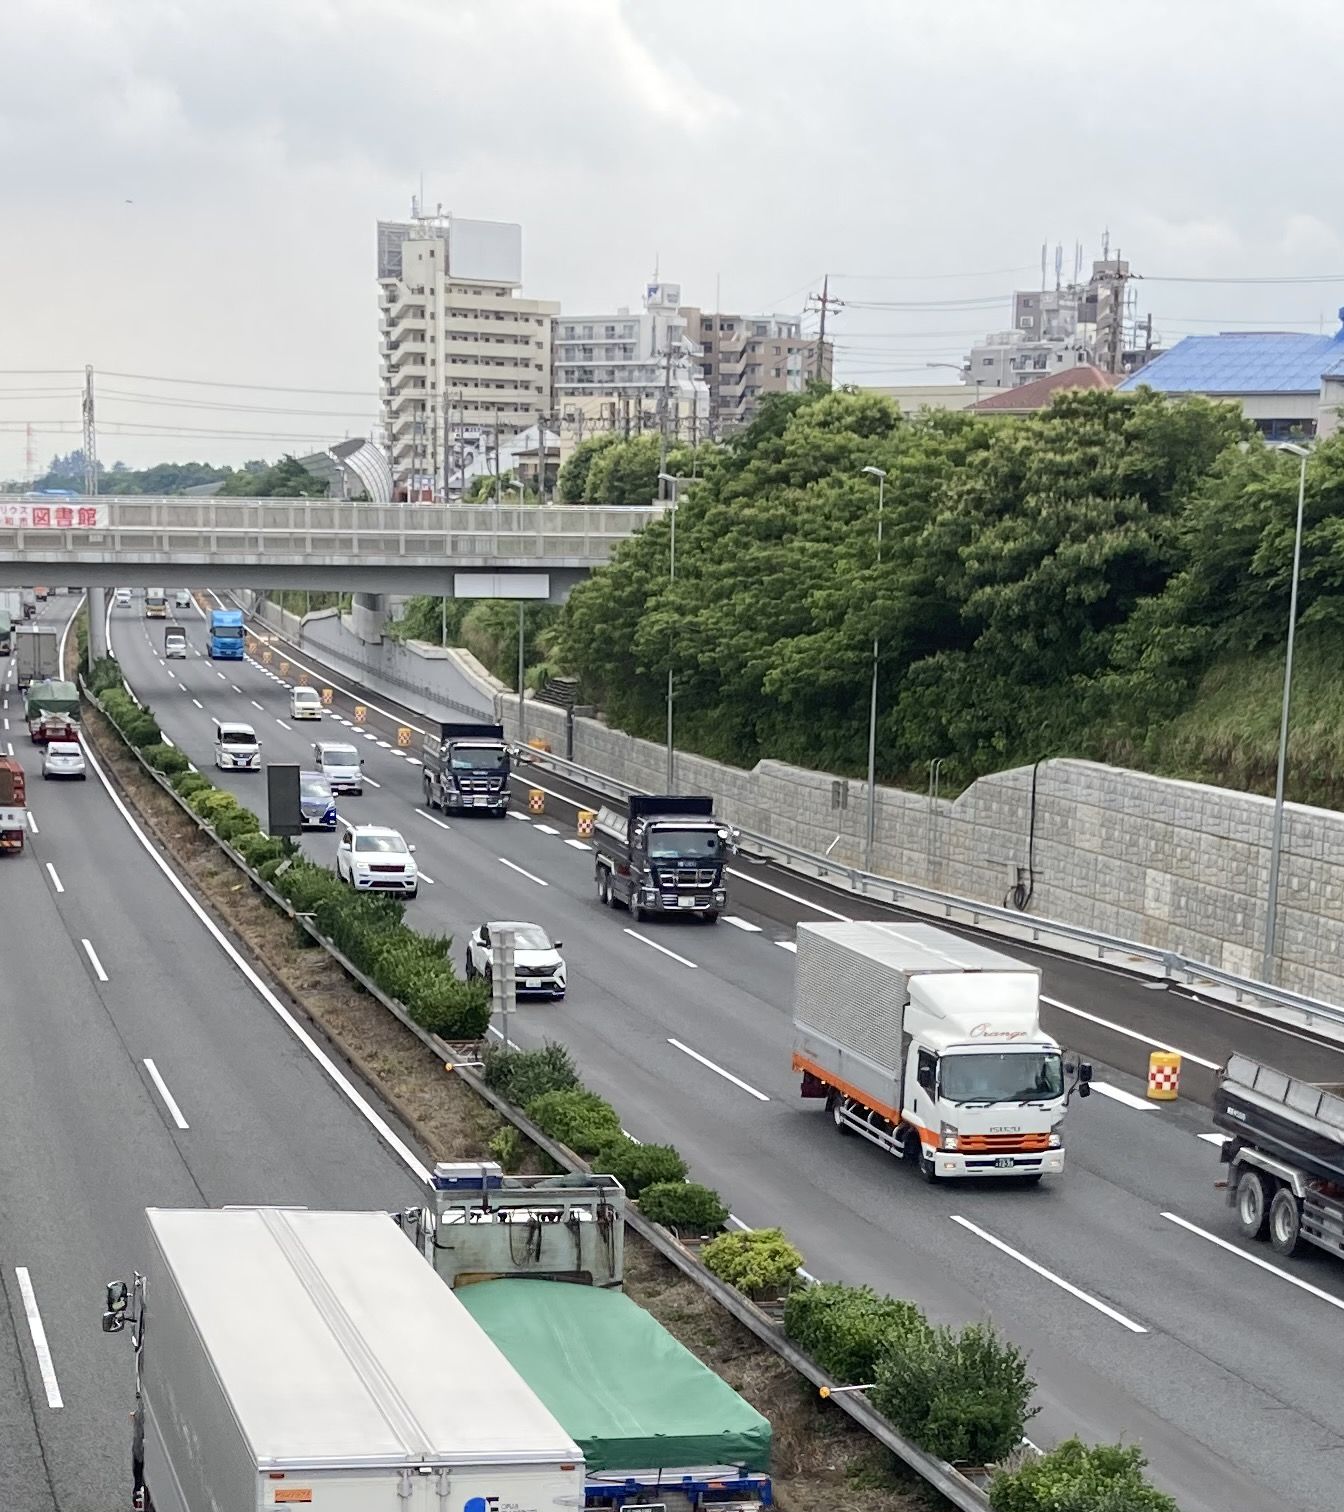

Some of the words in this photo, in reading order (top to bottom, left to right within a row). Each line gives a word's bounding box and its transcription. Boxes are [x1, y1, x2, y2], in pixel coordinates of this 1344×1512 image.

[32, 506, 97, 528] 図書館
[969, 1023, 1027, 1040] Orange
